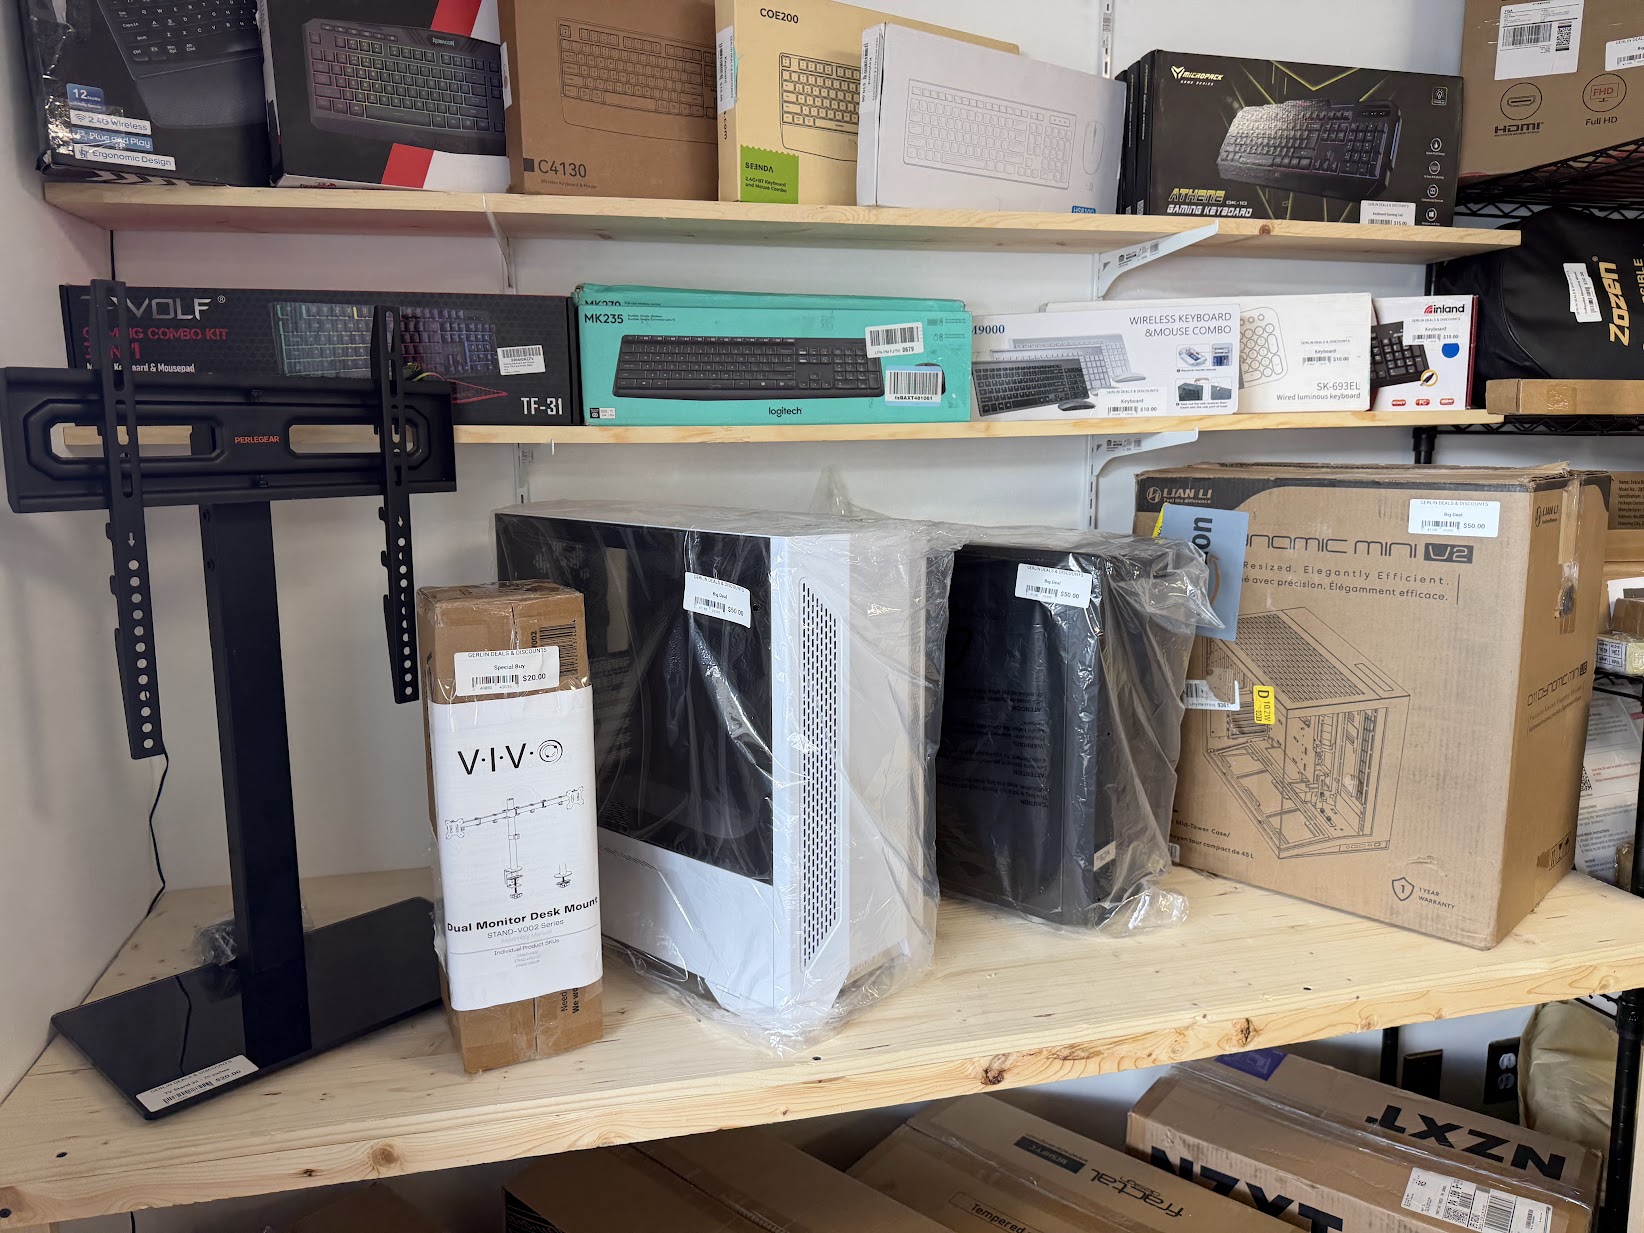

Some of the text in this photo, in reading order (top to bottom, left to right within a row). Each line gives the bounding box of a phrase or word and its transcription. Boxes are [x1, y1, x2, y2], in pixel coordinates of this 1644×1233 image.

[759, 7, 799, 24] COE200
[72, 88, 88, 99] 12
[1593, 87, 1614, 97] FHD
[88, 116, 148, 131] 2.4G Wireless
[1585, 116, 1618, 126] Full HD
[1494, 122, 1542, 134] HDMI
[89, 132, 110, 142] Plug
[130, 138, 151, 149] Play
[92, 150, 172, 167] Ergonomic Design
[538, 159, 587, 179] C4130
[764, 180, 787, 188] Keyboard
[770, 186, 787, 194] Combo
[1168, 187, 1226, 204] ATHENE
[1166, 204, 1253, 217] GAMING KEYBOARD
[1433, 304, 1465, 314] inland
[584, 313, 624, 324] MK235
[1129, 312, 1232, 326] WIRELESS KEYBOARD
[150, 328, 228, 340] COMBO KIT
[1144, 325, 1232, 338] &MOUSE COMBO
[150, 363, 196, 374] & Mousepad
[1316, 382, 1361, 392] SK-693EL
[1329, 392, 1361, 400] keyboard
[520, 397, 563, 416] TF-31
[768, 406, 802, 418] logitech
[234, 435, 280, 444] PERLEGEAR
[1162, 488, 1213, 498] LIAN LI
[1463, 522, 1486, 530] $50.00
[1353, 540, 1418, 559] mini
[1243, 561, 1450, 586] Resized. Elegantly Efficient.
[1060, 590, 1080, 599] $50.00
[1252, 576, 1449, 601] avec précision. Élégamment efficace.
[515, 648, 547, 656] DISCOUNTS
[522, 672, 546, 682] $20.00
[1257, 689, 1270, 699] D
[1175, 820, 1231, 838] Mid-Tower Case/
[1188, 838, 1202, 846] tour
[1202, 842, 1231, 854] compact
[1231, 848, 1240, 856] de
[1423, 888, 1440, 896] YEAR
[1418, 895, 1456, 910] WARRANTY
[447, 896, 598, 932] Dual Monitor Desk Mount
[487, 919, 564, 939] STAND-V002 Series
[494, 938, 560, 956] Individual Product SKUs
[560, 990, 568, 1012] Need
[572, 1000, 580, 1014] We
[1090, 1168, 1184, 1218] fractal
[970, 1203, 1026, 1233] Tempered
